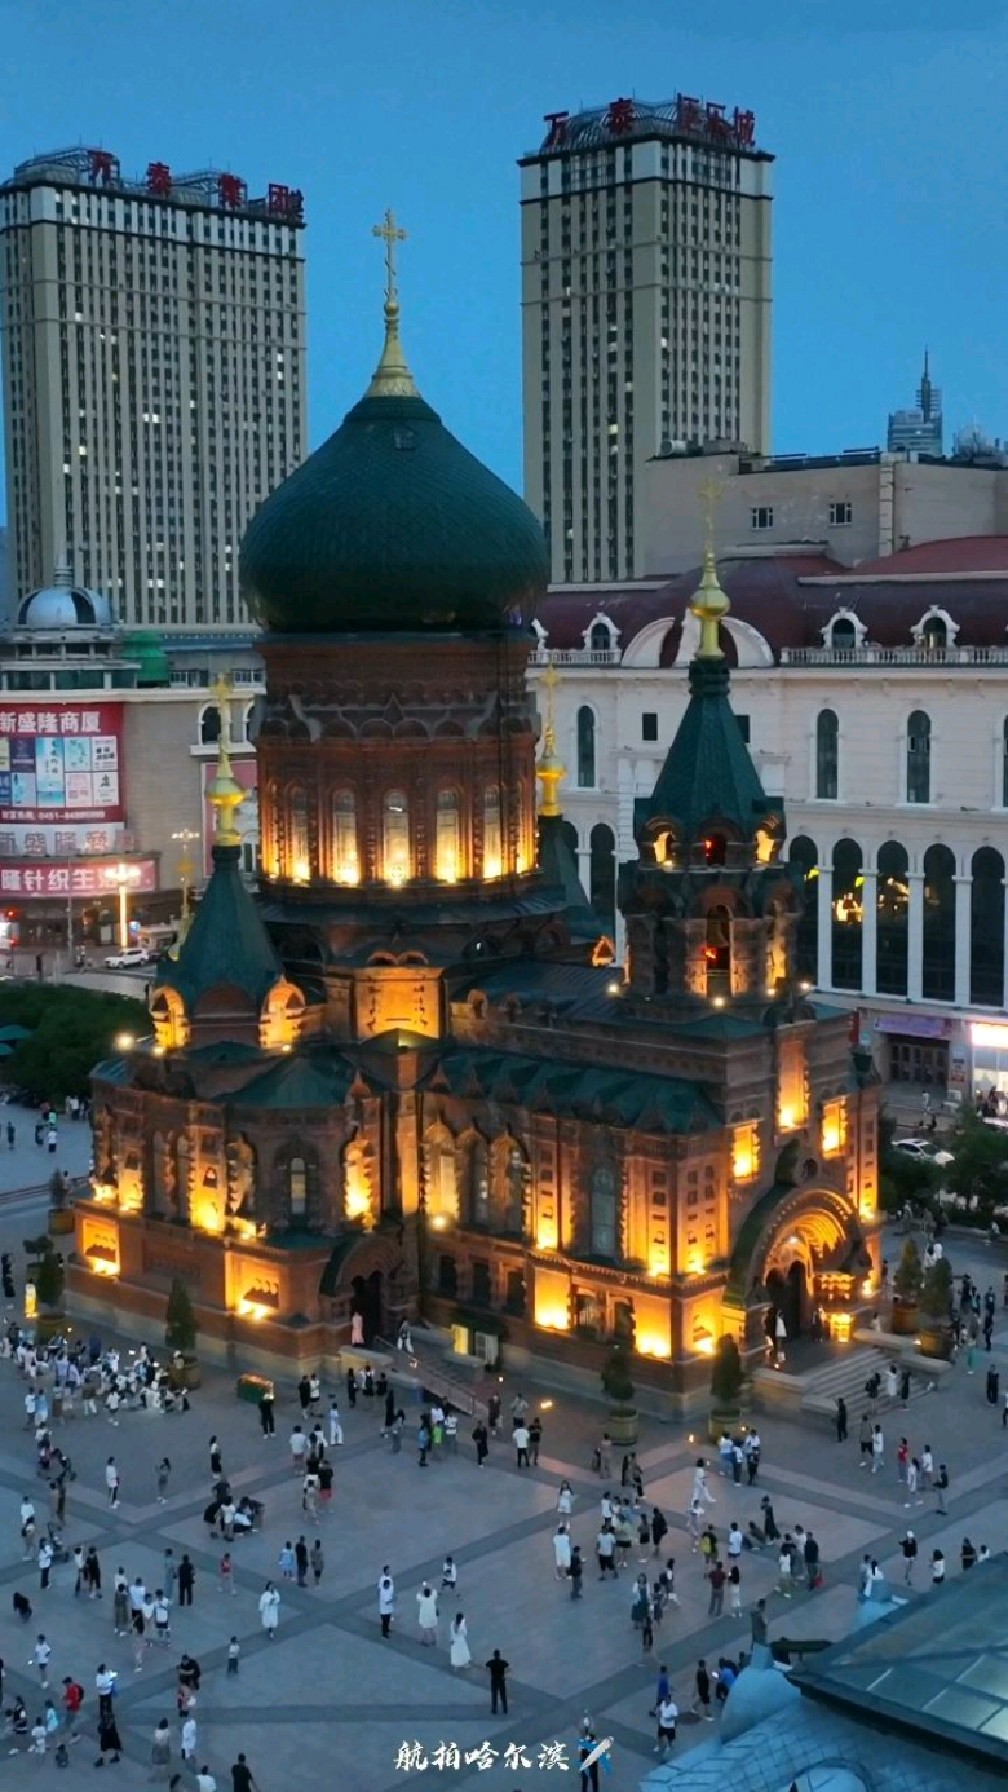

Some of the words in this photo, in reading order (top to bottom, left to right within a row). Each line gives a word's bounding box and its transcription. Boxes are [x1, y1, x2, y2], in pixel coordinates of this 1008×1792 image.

[0, 711, 101, 733] 新盛隆商厦
